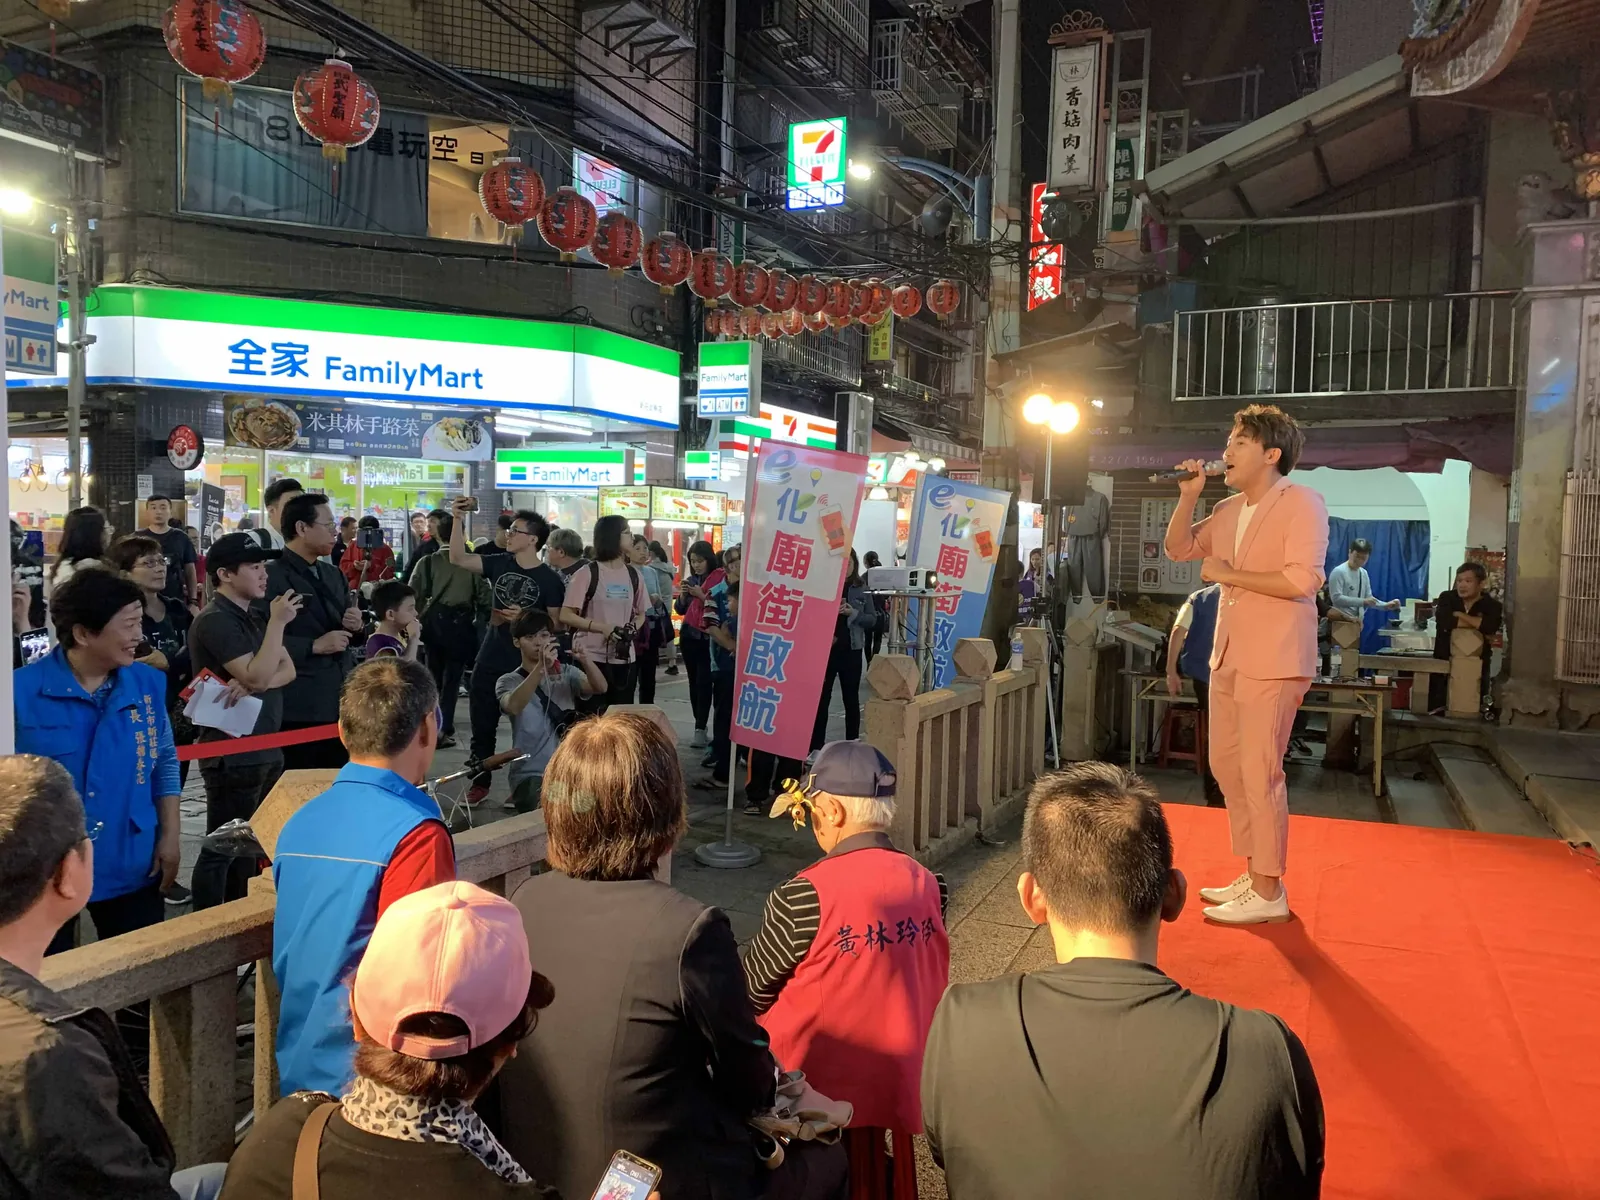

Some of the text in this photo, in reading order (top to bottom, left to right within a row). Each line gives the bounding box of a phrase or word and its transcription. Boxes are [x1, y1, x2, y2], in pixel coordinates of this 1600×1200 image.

[1062, 86, 1083, 175] 香菇肉羹
[228, 338, 483, 391] 全家 FamilyMart
[701, 373, 747, 384] FamilyMart
[306, 412, 420, 437] 米其林手路菜
[343, 471, 401, 488] FailyMart
[532, 467, 611, 483] FamilyMart
[832, 915, 938, 958] 黃林玲玲
